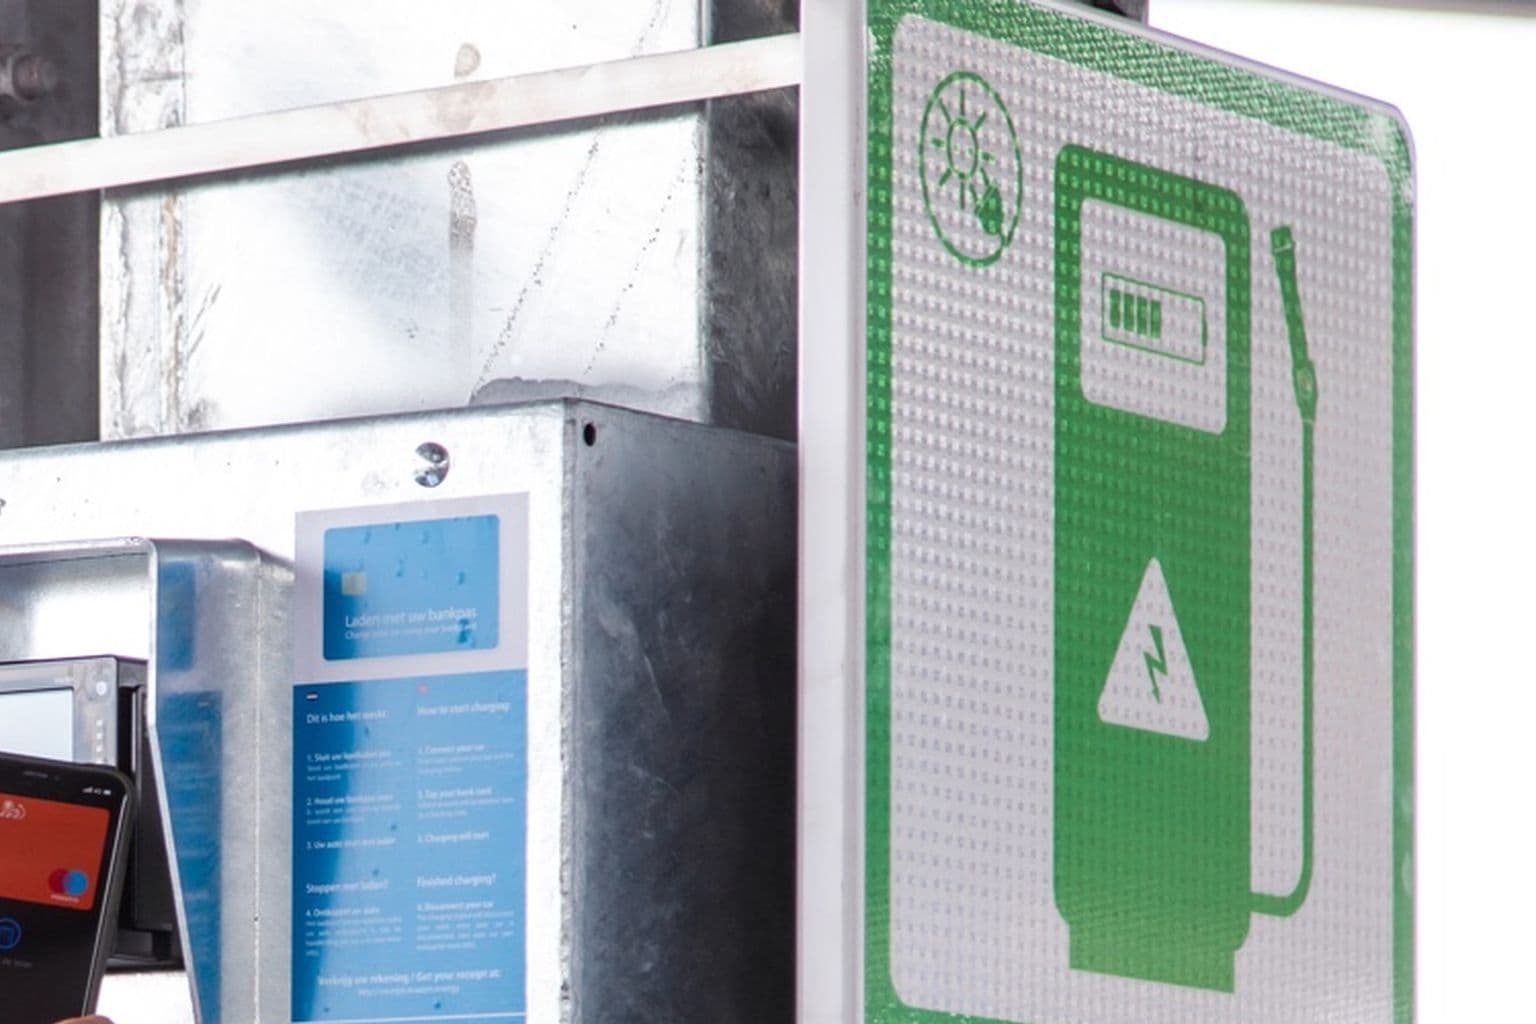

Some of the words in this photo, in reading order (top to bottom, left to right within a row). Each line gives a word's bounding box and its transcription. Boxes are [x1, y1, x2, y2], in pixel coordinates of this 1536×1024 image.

[345, 614, 381, 628] Laden
[382, 612, 406, 625] met
[306, 713, 320, 724] Dit
[330, 711, 345, 722] hoe
[434, 971, 454, 983] your
